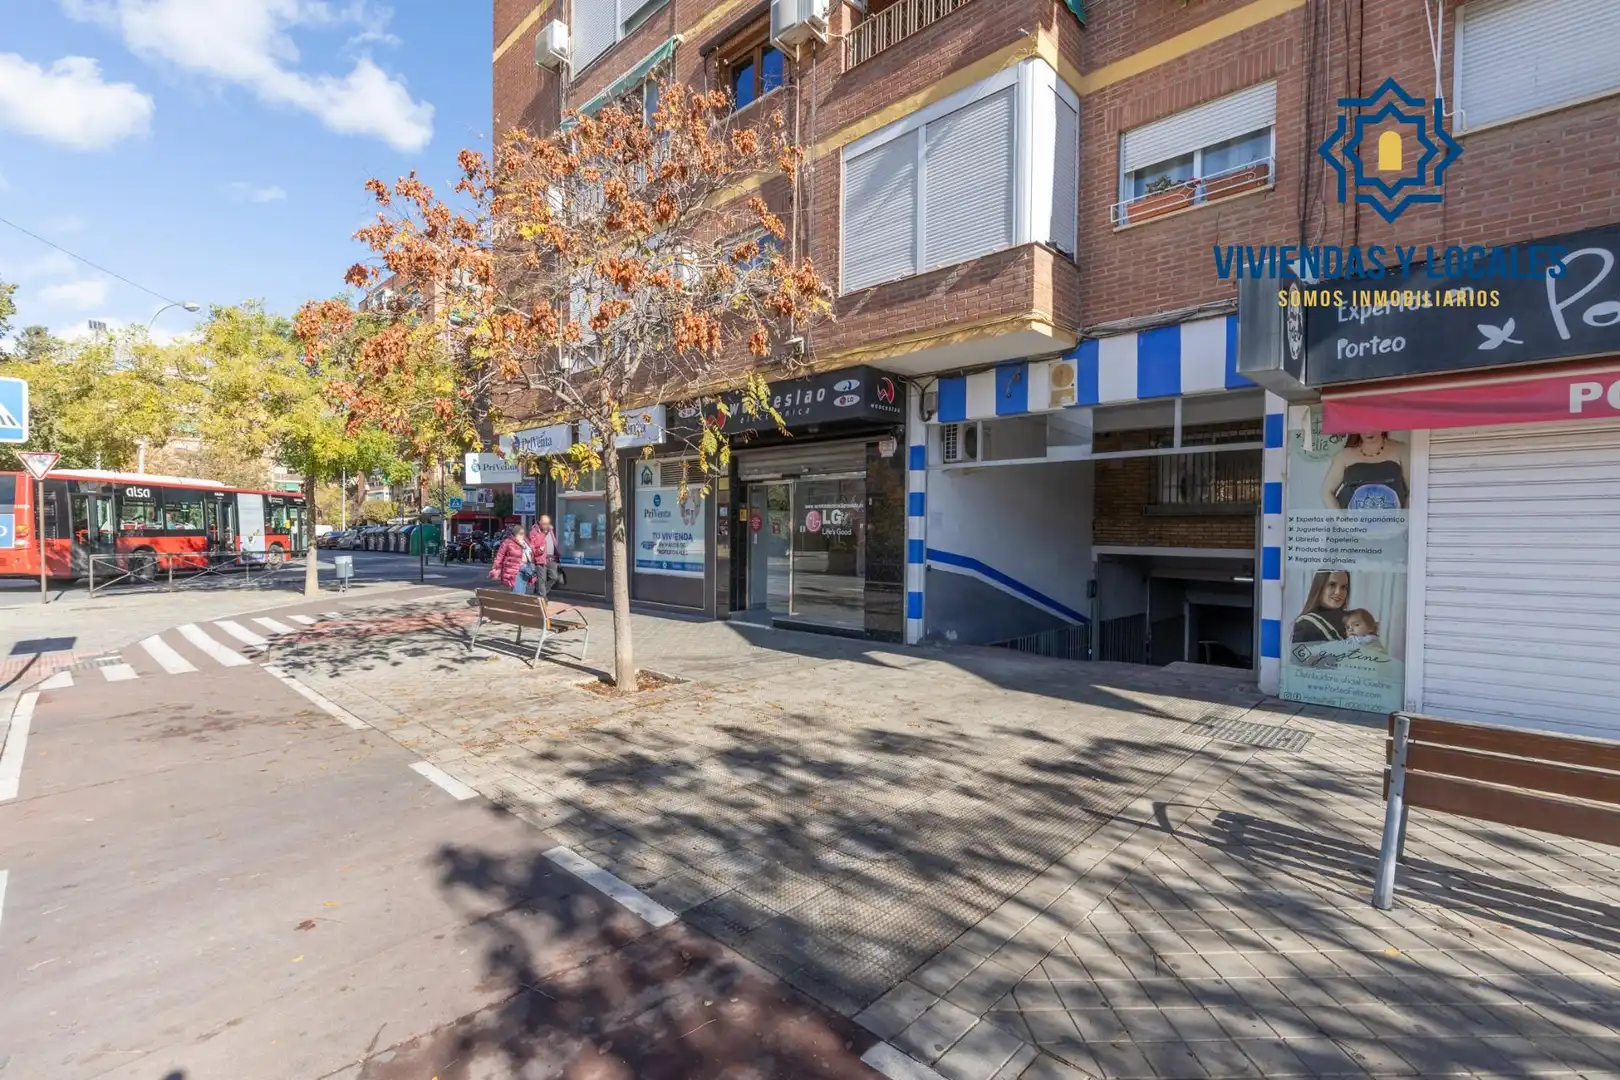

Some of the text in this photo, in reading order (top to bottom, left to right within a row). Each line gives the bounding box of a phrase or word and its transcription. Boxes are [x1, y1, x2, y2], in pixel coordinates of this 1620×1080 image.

[1337, 336, 1406, 359] Porteo
[730, 388, 826, 416] weslao
[126, 486, 150, 498] alsa
[822, 509, 842, 525] LG
[836, 528, 852, 536] Good
